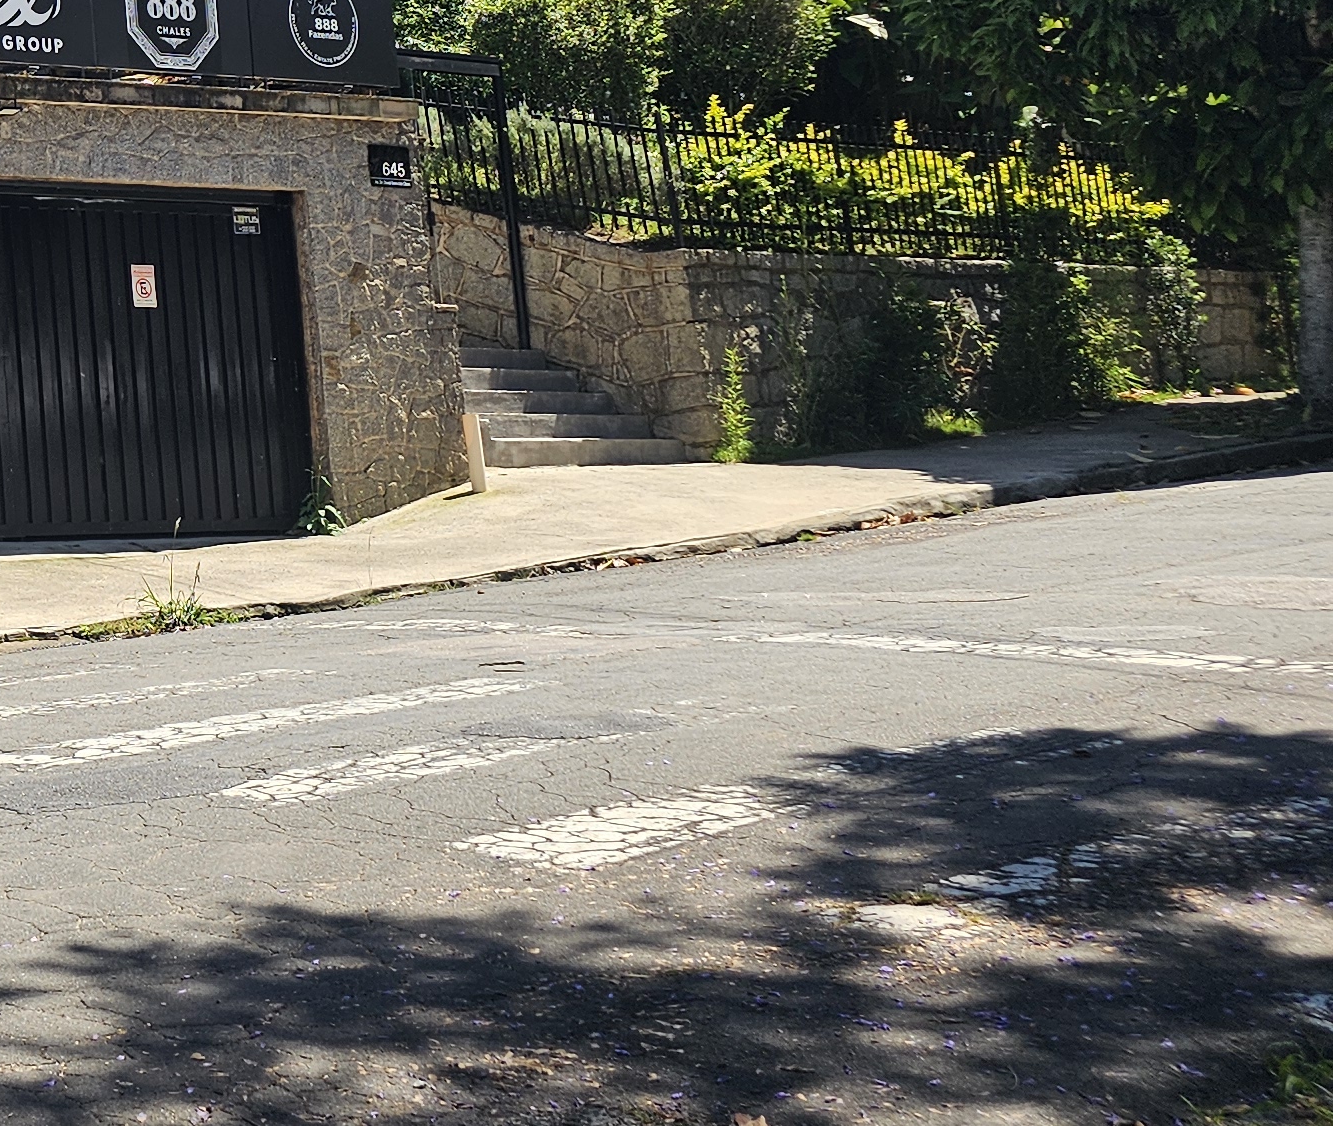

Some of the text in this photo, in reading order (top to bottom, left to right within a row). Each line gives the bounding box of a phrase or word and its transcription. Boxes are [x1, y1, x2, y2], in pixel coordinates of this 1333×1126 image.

[156, 25, 192, 37] CHALES
[314, 17, 339, 32] 888
[1, 34, 64, 54] GROUP
[382, 161, 406, 178] 645
